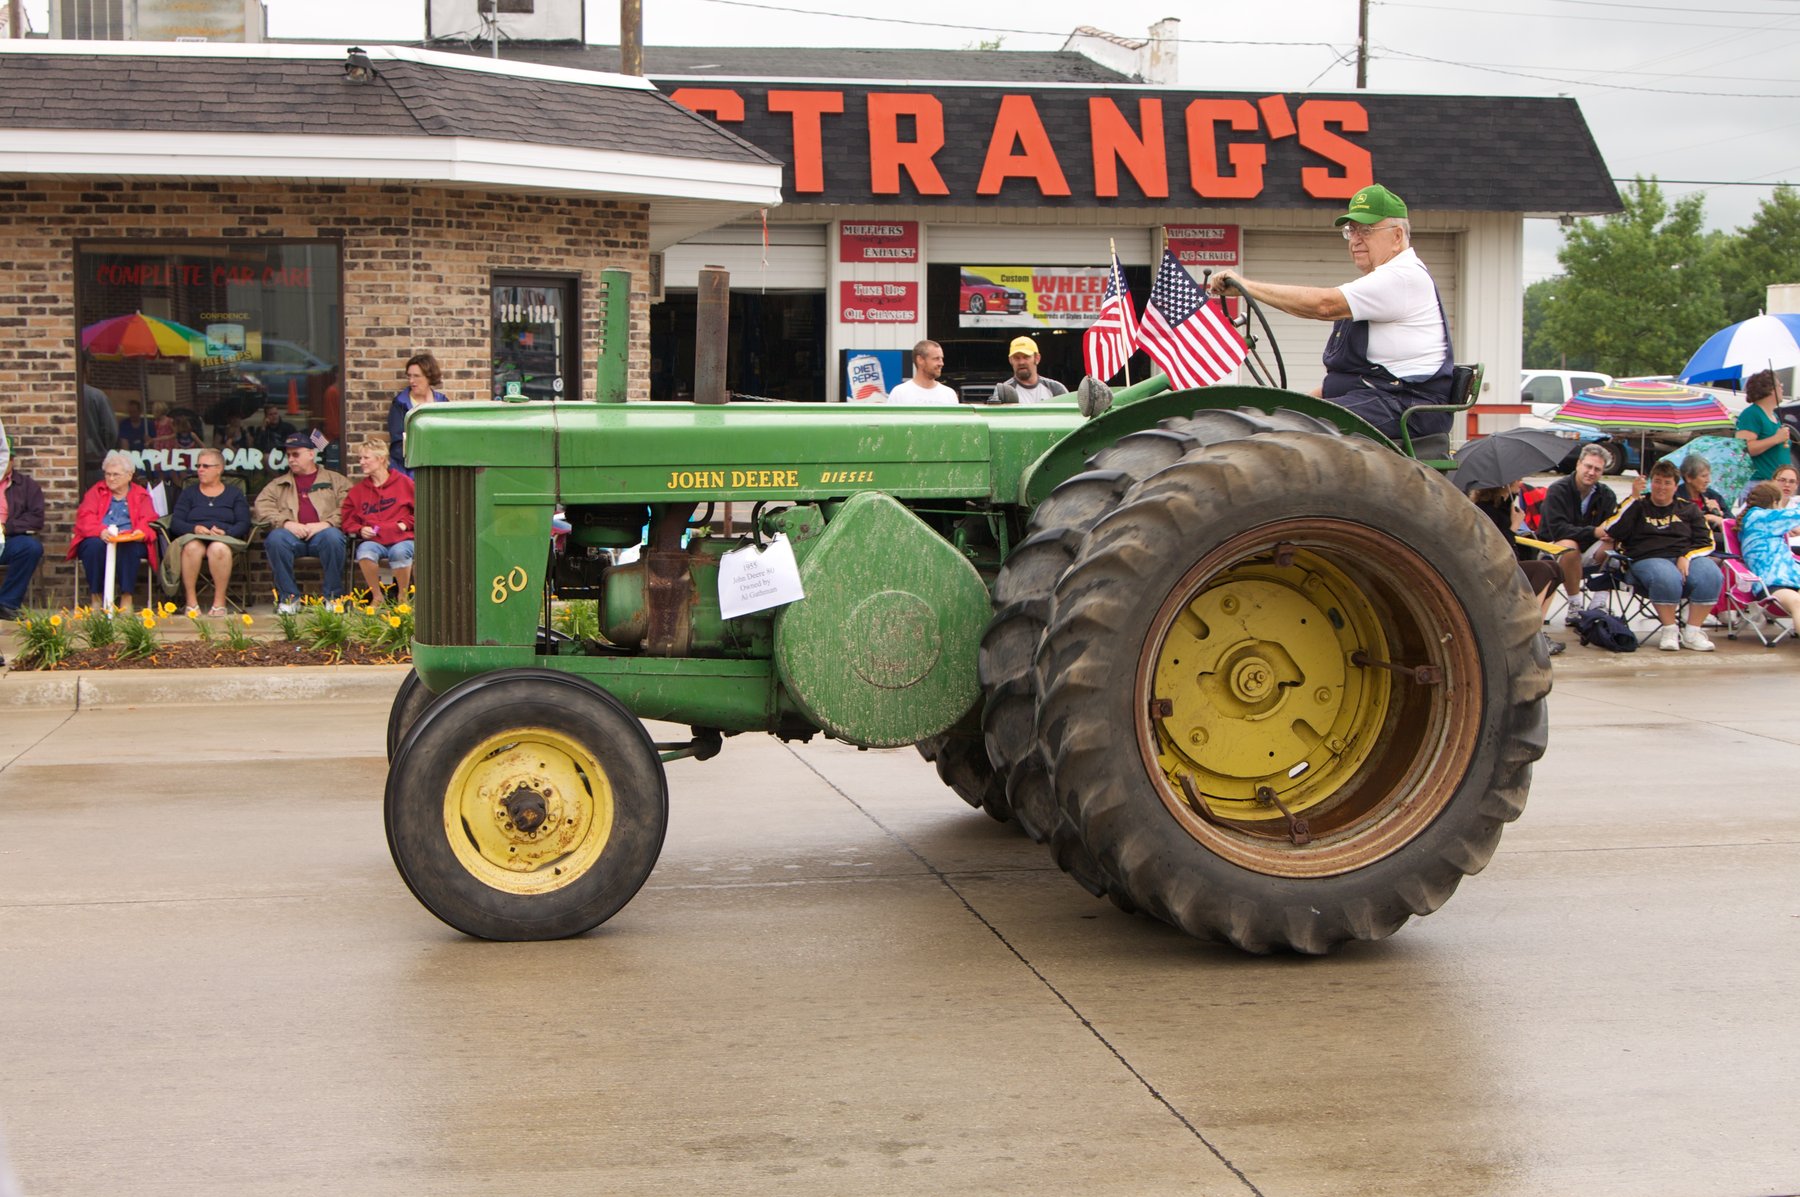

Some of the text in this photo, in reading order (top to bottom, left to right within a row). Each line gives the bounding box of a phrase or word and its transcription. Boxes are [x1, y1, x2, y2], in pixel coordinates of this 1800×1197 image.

[843, 225, 904, 236] MUFFLERS
[1168, 228, 1225, 239] ALIGNMENT
[863, 247, 916, 258] EXHAUST
[1196, 251, 1237, 261] SERVICE
[96, 264, 205, 287] COMPLETE
[213, 265, 256, 288] CAR
[1000, 274, 1029, 283] Custom
[853, 363, 875, 375] DIET
[852, 372, 880, 384] PEPSI
[106, 449, 206, 471] MPLET
[222, 447, 263, 470] CAR
[667, 471, 874, 489] JOHN DEERE DIESEL
[733, 576, 746, 584] John
[747, 572, 765, 580] Deere
[491, 566, 528, 604] 80
